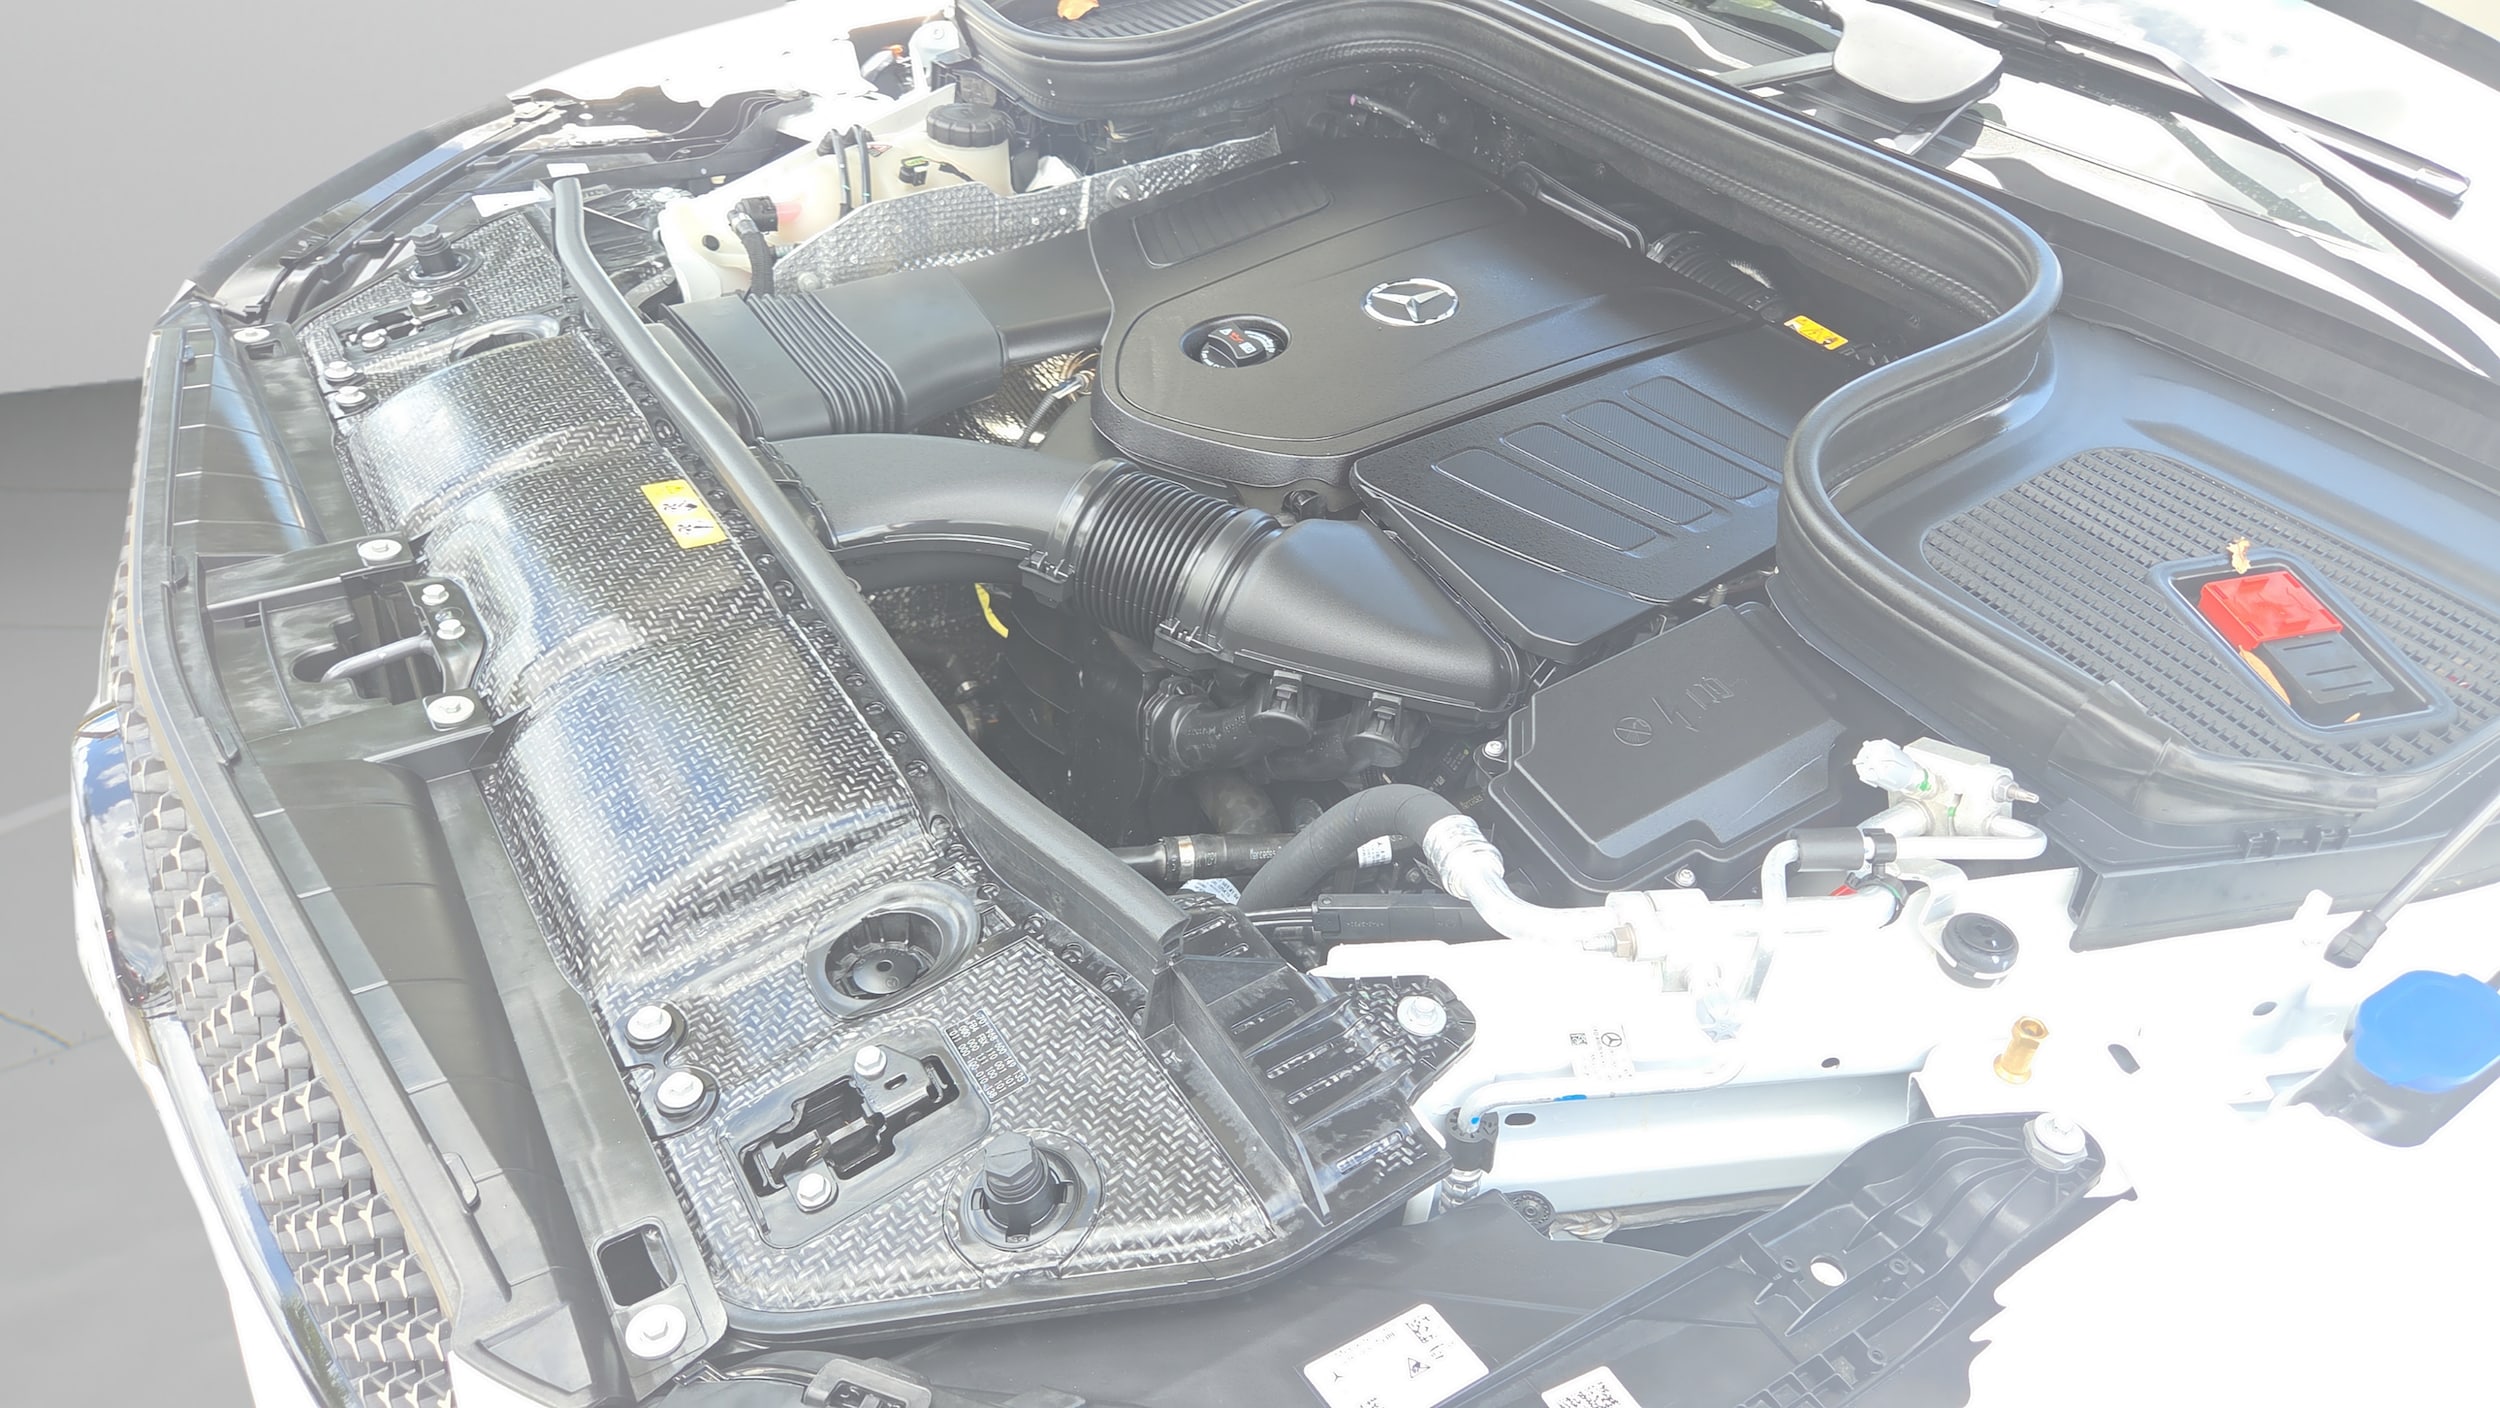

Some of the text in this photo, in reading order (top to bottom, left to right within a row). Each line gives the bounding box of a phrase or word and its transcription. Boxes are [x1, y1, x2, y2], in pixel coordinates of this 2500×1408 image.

[949, 1030, 961, 1042] 011
[976, 1015, 987, 1026] 701
[1013, 1070, 1025, 1081] 135
[986, 1048, 998, 1060] 110
[994, 1061, 1006, 1073] 001
[1004, 1075, 1016, 1087] 101
[986, 1067, 997, 1079] 100
[995, 1081, 1006, 1092] 101
